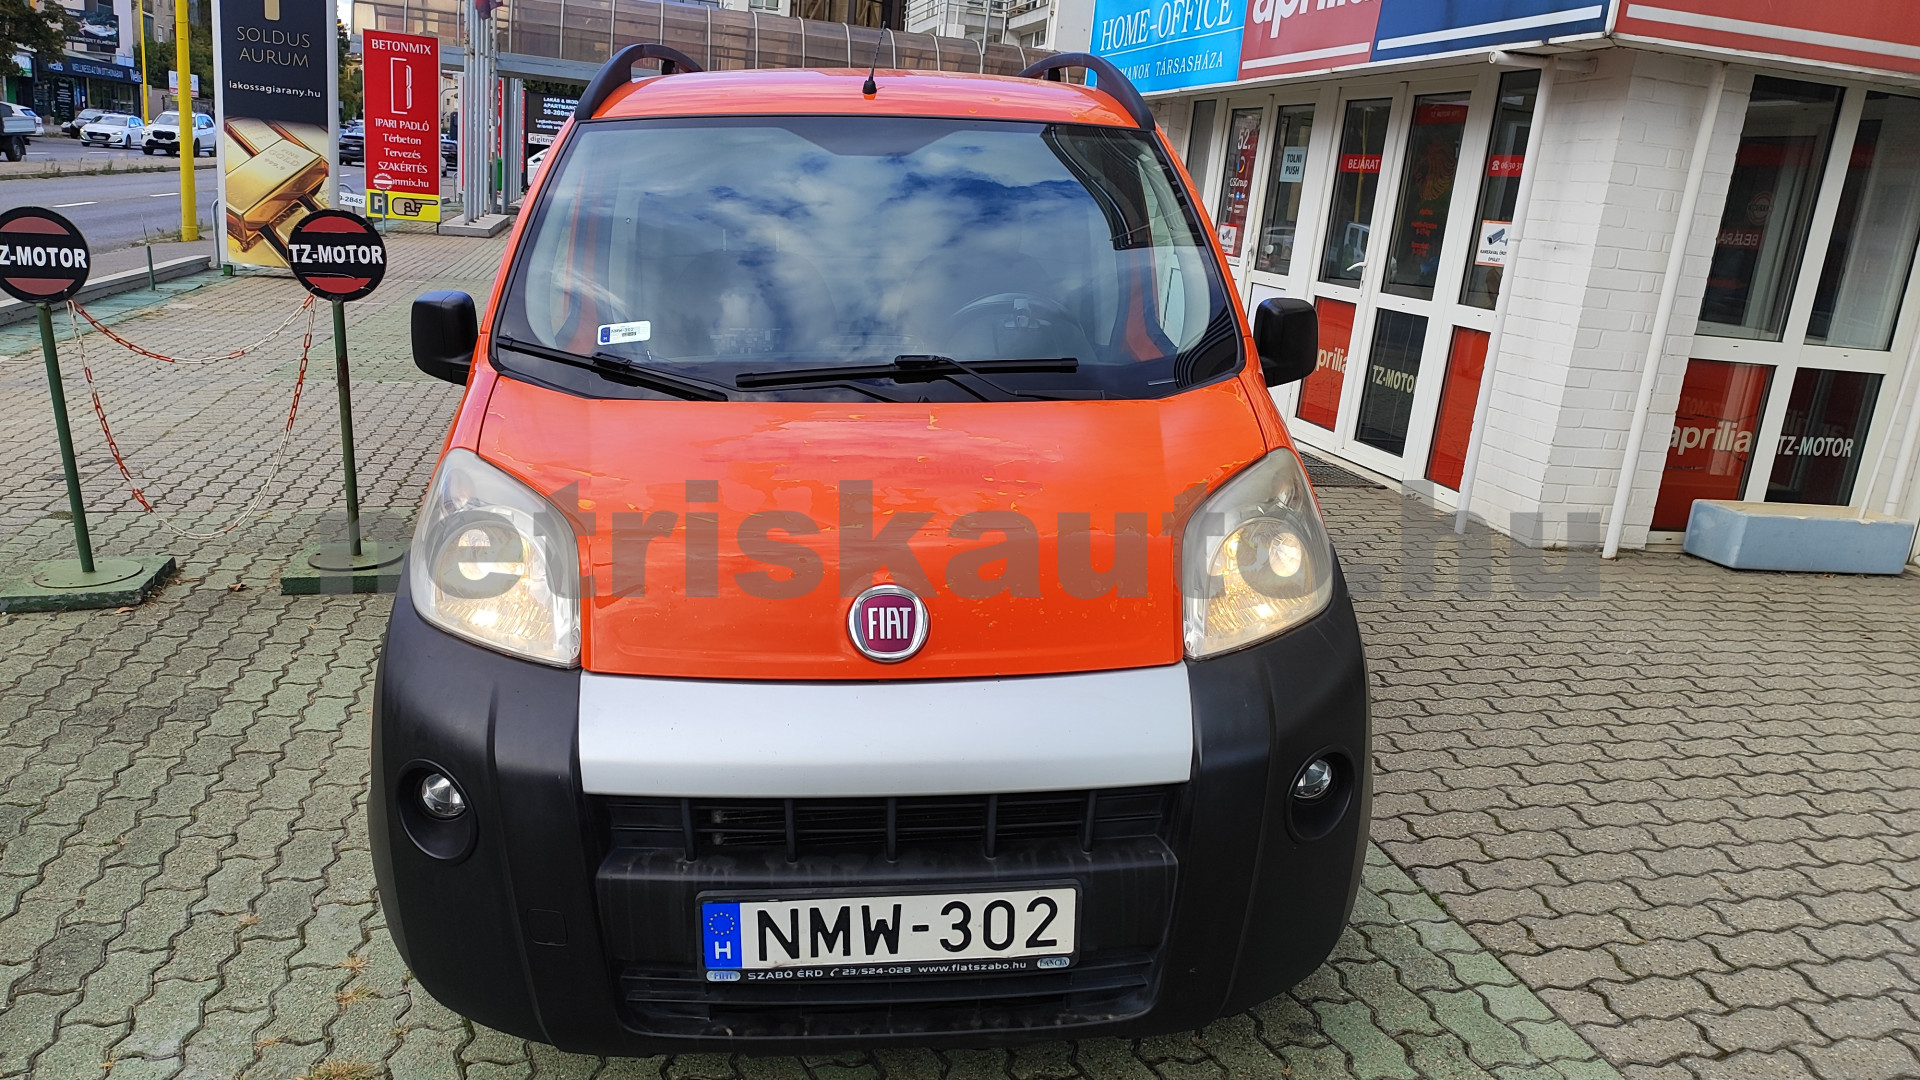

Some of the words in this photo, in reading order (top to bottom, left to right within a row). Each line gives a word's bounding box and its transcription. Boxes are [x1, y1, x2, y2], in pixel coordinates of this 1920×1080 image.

[1100, 0, 1233, 51] HOME-OFFICE
[236, 26, 311, 48] SOLDUS
[371, 38, 431, 55] BETONMIX
[239, 47, 309, 68] AURUM
[1156, 49, 1223, 77] TÁRSASHÁZA
[229, 79, 321, 98] lakossagiarany.hu
[375, 118, 397, 129] IPARI
[400, 120, 430, 131] PADLÓ
[382, 133, 422, 145] Térbeton
[384, 147, 421, 160] Tervezés
[1347, 157, 1380, 170] BEJÁRAT
[378, 160, 428, 174] SZAKÉRTÉS
[1285, 165, 1300, 176] PUSH
[0, 245, 88, 268] Z-MOTOR
[288, 243, 383, 266] TZ-MOTOR
[1372, 364, 1418, 394] TZ-MOTO
[1669, 421, 1752, 455] aprilia
[1777, 435, 1854, 457] TZ-MOTOR
[868, 607, 912, 639] FIAT
[757, 896, 1059, 962] NMW-302
[715, 941, 732, 960] H
[747, 968, 793, 980] SZABÓ
[797, 968, 824, 978] ÉRD
[842, 966, 912, 976] 23/524-028
[918, 961, 1027, 973] www.fiatszabo.hu
